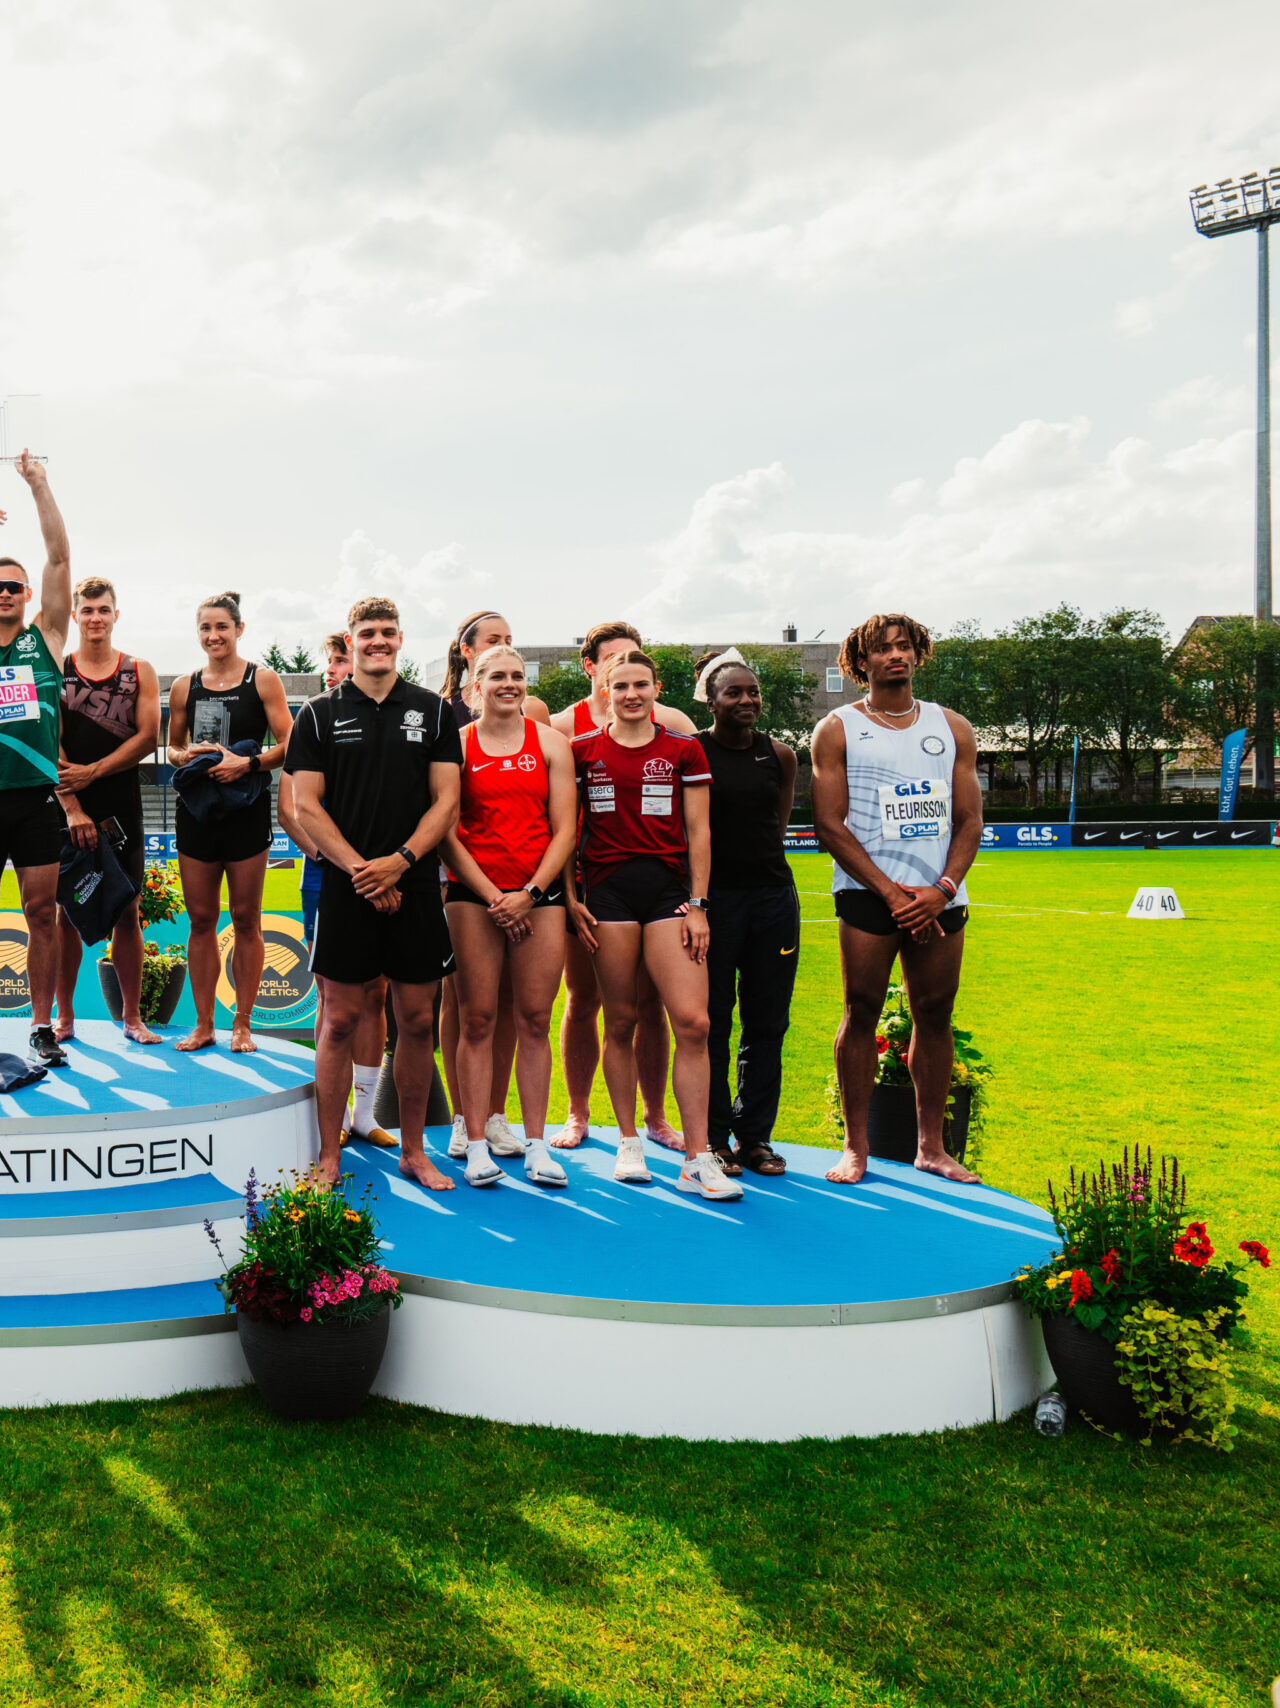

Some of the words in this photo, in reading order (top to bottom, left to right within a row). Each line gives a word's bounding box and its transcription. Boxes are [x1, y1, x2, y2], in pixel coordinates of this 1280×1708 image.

[4, 706, 25, 714] PLAN
[65, 683, 133, 725] VSK
[593, 786, 613, 795] sera
[885, 800, 947, 820] FLEURISSON
[918, 824, 938, 832] PLAN
[1136, 894, 1154, 912] 40
[1160, 894, 1176, 912] 40
[257, 988, 300, 997] HLETICS
